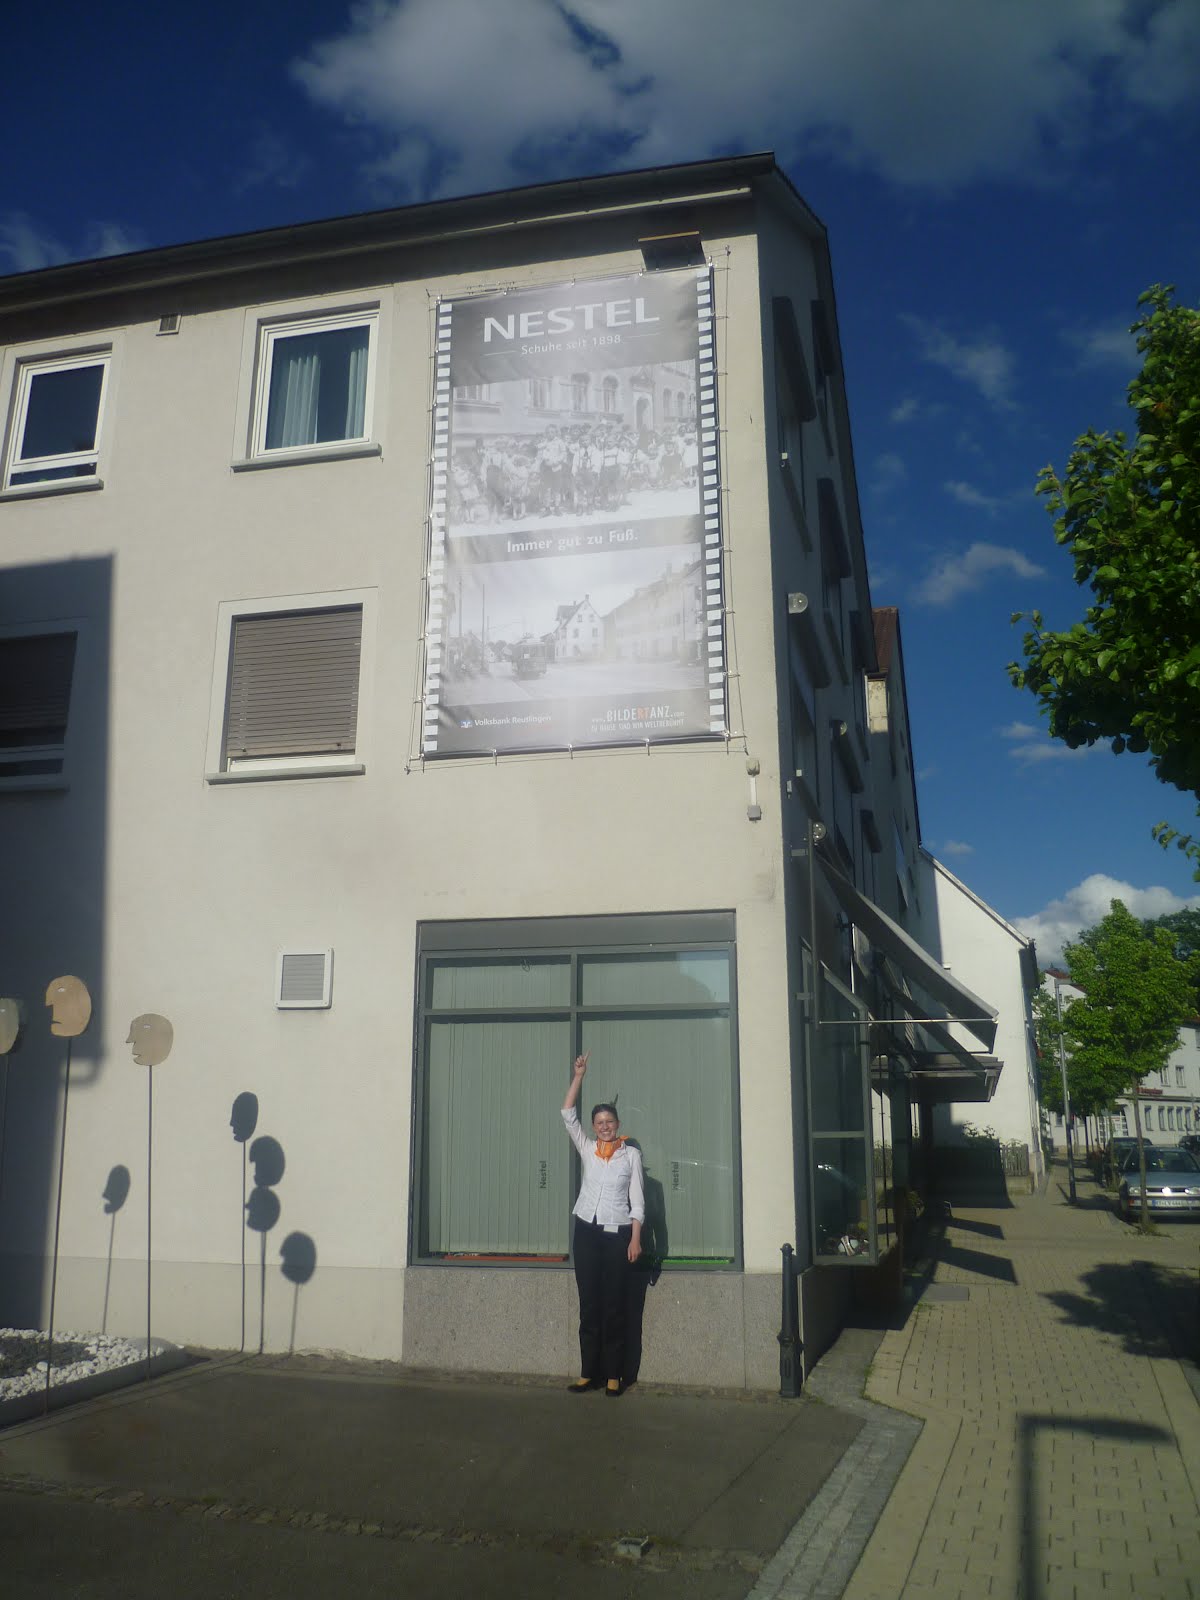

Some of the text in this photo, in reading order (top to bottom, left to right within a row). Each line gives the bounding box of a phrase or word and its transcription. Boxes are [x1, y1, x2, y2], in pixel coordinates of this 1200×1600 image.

[484, 298, 660, 343] NESTEL
[521, 335, 622, 355] Schuhe seit 1898
[507, 529, 638, 553] Immer gut zu Fuß.
[474, 716, 552, 726] Volksbank Reutlingen
[538, 1160, 547, 1189] Nestel
[671, 1161, 679, 1190] Nestel
